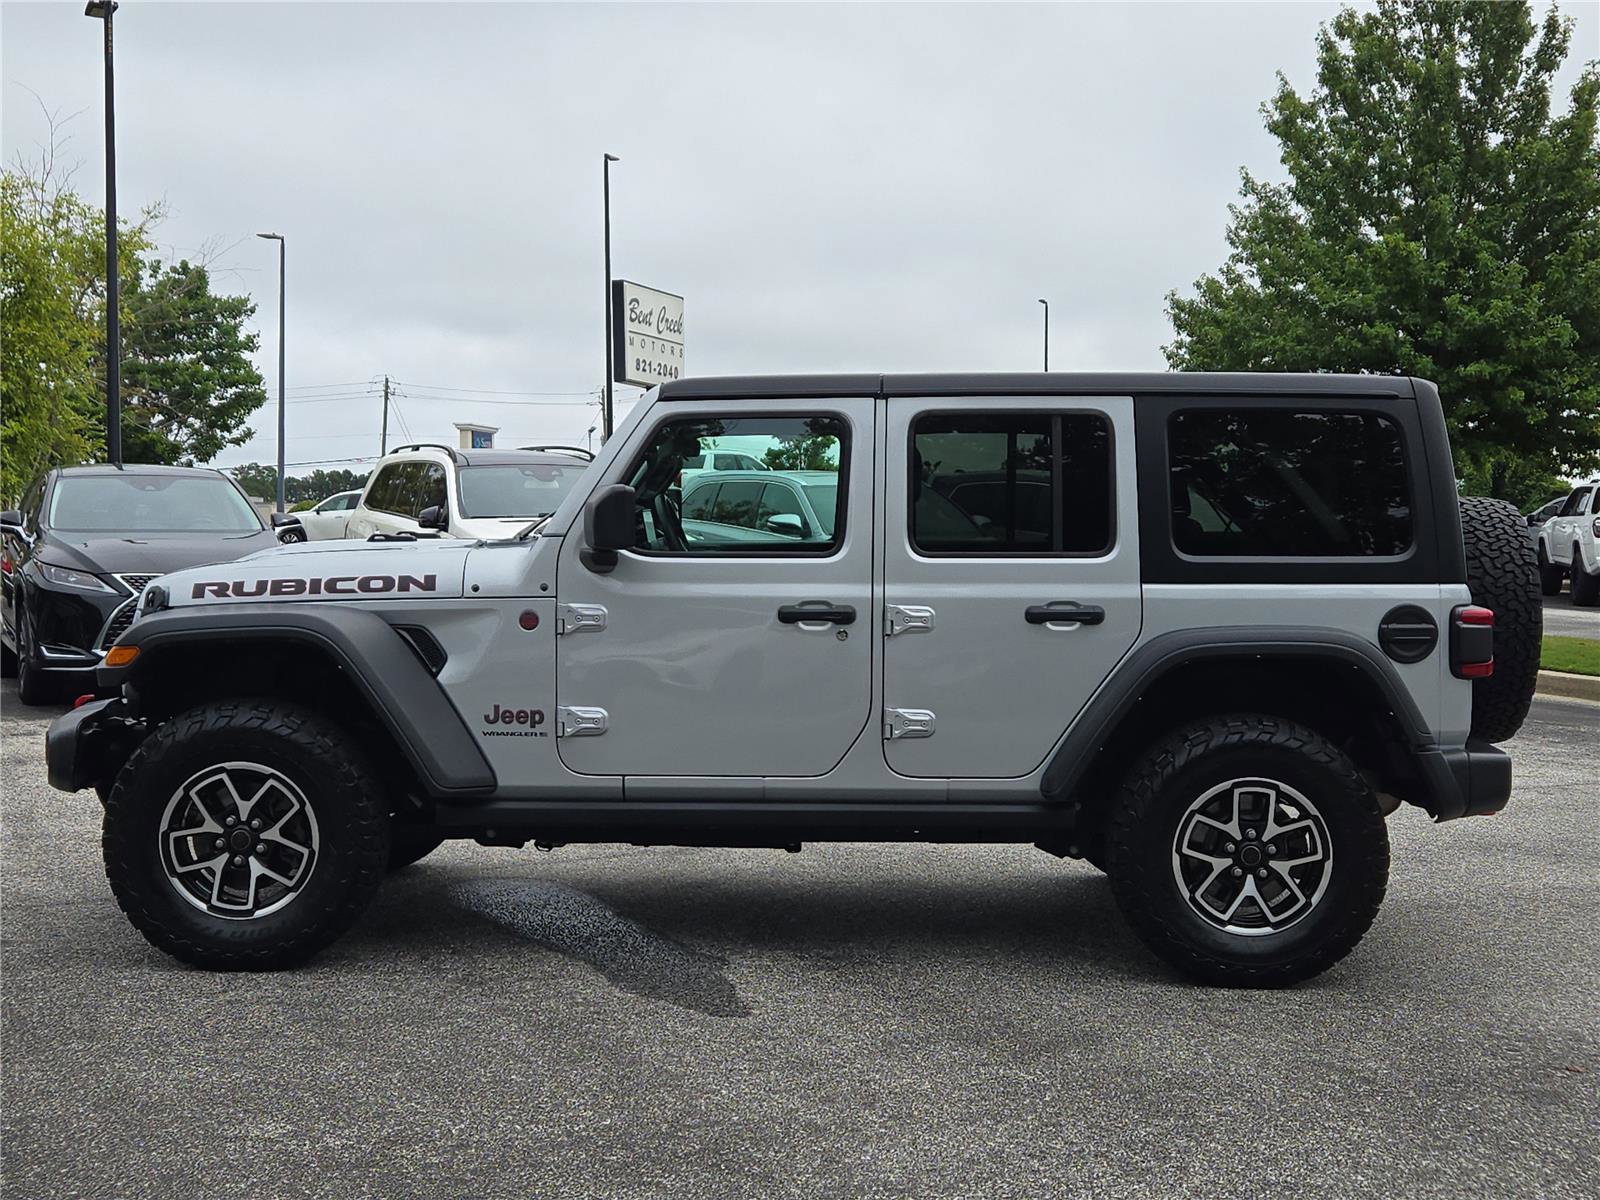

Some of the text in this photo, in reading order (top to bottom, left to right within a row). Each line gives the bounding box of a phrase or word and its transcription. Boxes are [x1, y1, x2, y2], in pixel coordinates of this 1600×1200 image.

[628, 298, 683, 335] Bent Creek
[629, 336, 683, 358] MOTORS
[635, 358, 679, 380] 821-2040
[191, 574, 437, 599] RUBICON
[484, 704, 545, 729] Jeep
[482, 730, 538, 738] WRANGLER
